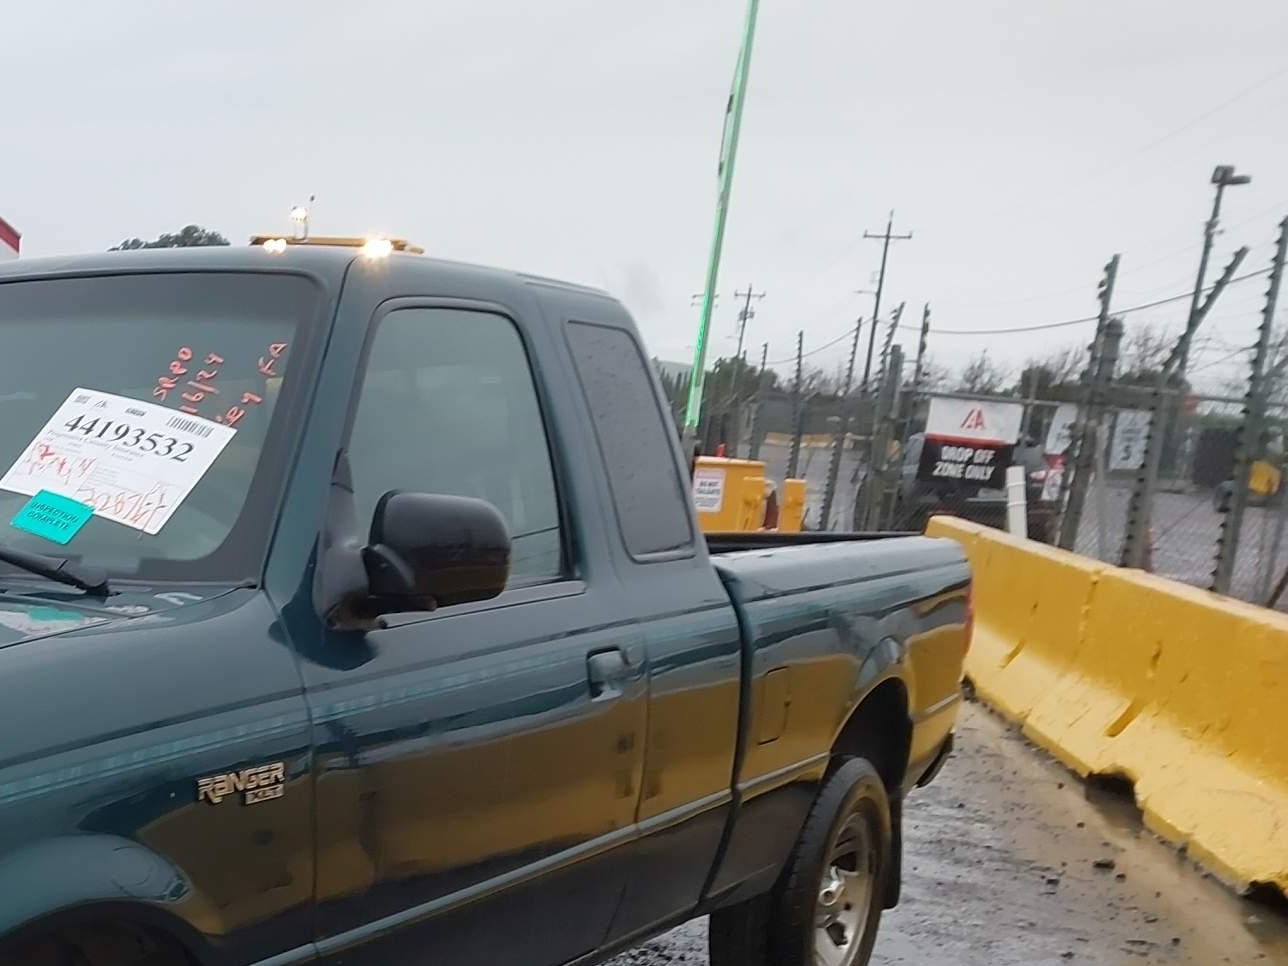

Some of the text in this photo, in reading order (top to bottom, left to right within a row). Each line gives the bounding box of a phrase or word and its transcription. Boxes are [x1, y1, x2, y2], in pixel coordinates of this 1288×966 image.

[64, 414, 194, 462] 44193532
[941, 445, 996, 464] DROP OFF
[932, 461, 995, 480] ZONE ONLY
[197, 762, 285, 804] RANGER
